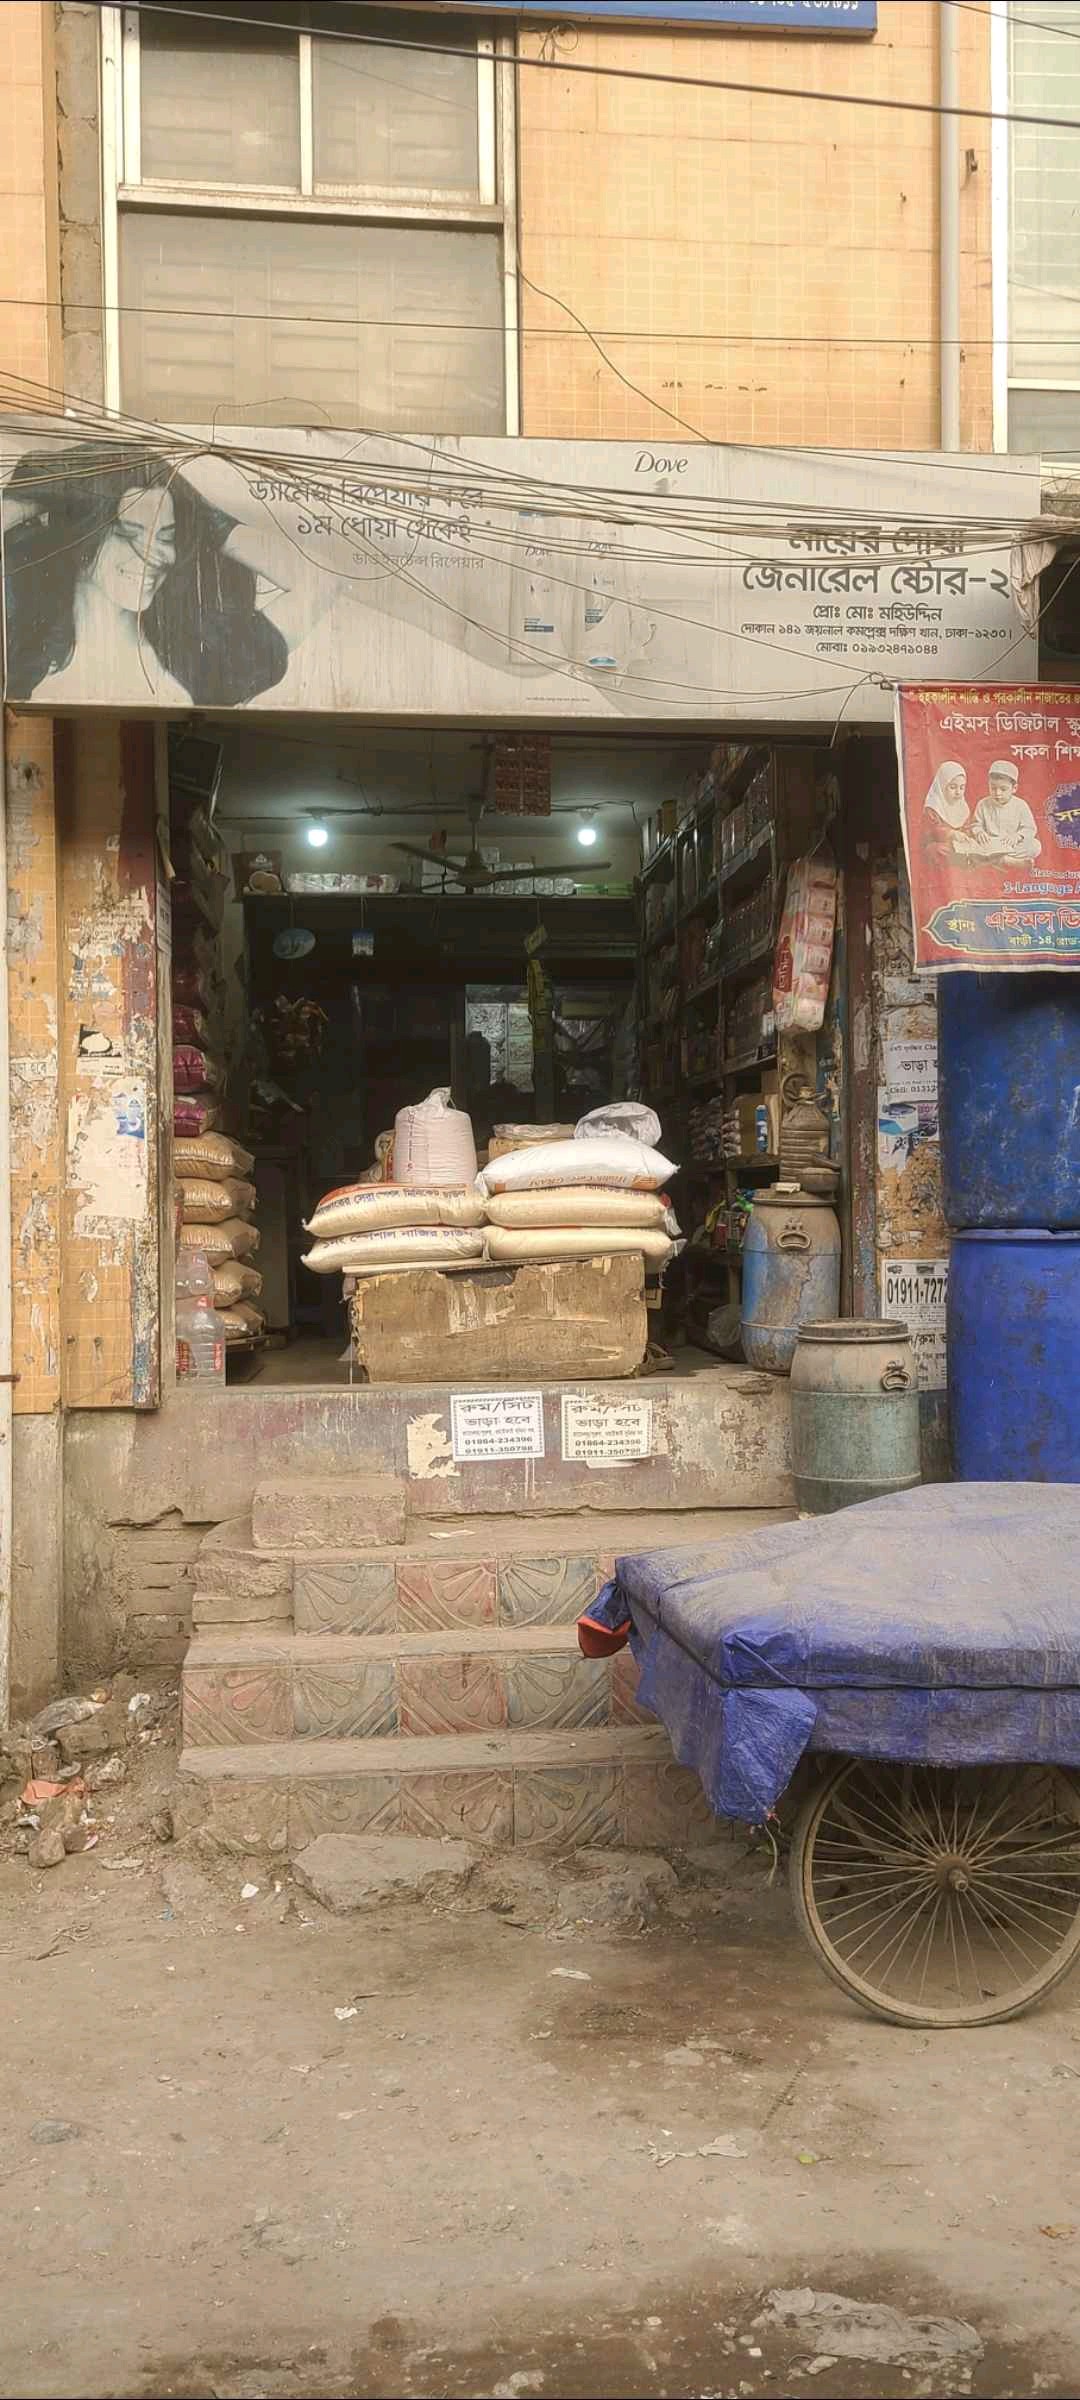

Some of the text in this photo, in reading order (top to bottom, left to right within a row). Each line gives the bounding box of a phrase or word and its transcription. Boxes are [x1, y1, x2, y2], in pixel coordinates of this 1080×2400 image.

[634, 450, 689, 473] Dove
[297, 514, 472, 543] ১ম ধোয়া থেকেই
[742, 562, 881, 594] জেনারেল
[813, 602, 943, 622] প্রোঃ মোঃ মহিউদ্দিন
[740, 623, 776, 636] দোকান
[778, 625, 801, 635] ১৪১
[805, 624, 843, 637] জয়নাল
[995, 711, 1061, 733] ডিজিটাল
[1010, 744, 1050, 761] সকল
[900, 1060, 929, 1073] ভাড়া
[459, 1399, 535, 1413] রুম/সিট
[463, 1415, 532, 1428] ভাড়া হবে
[575, 1417, 640, 1429] ভাড়া হবে
